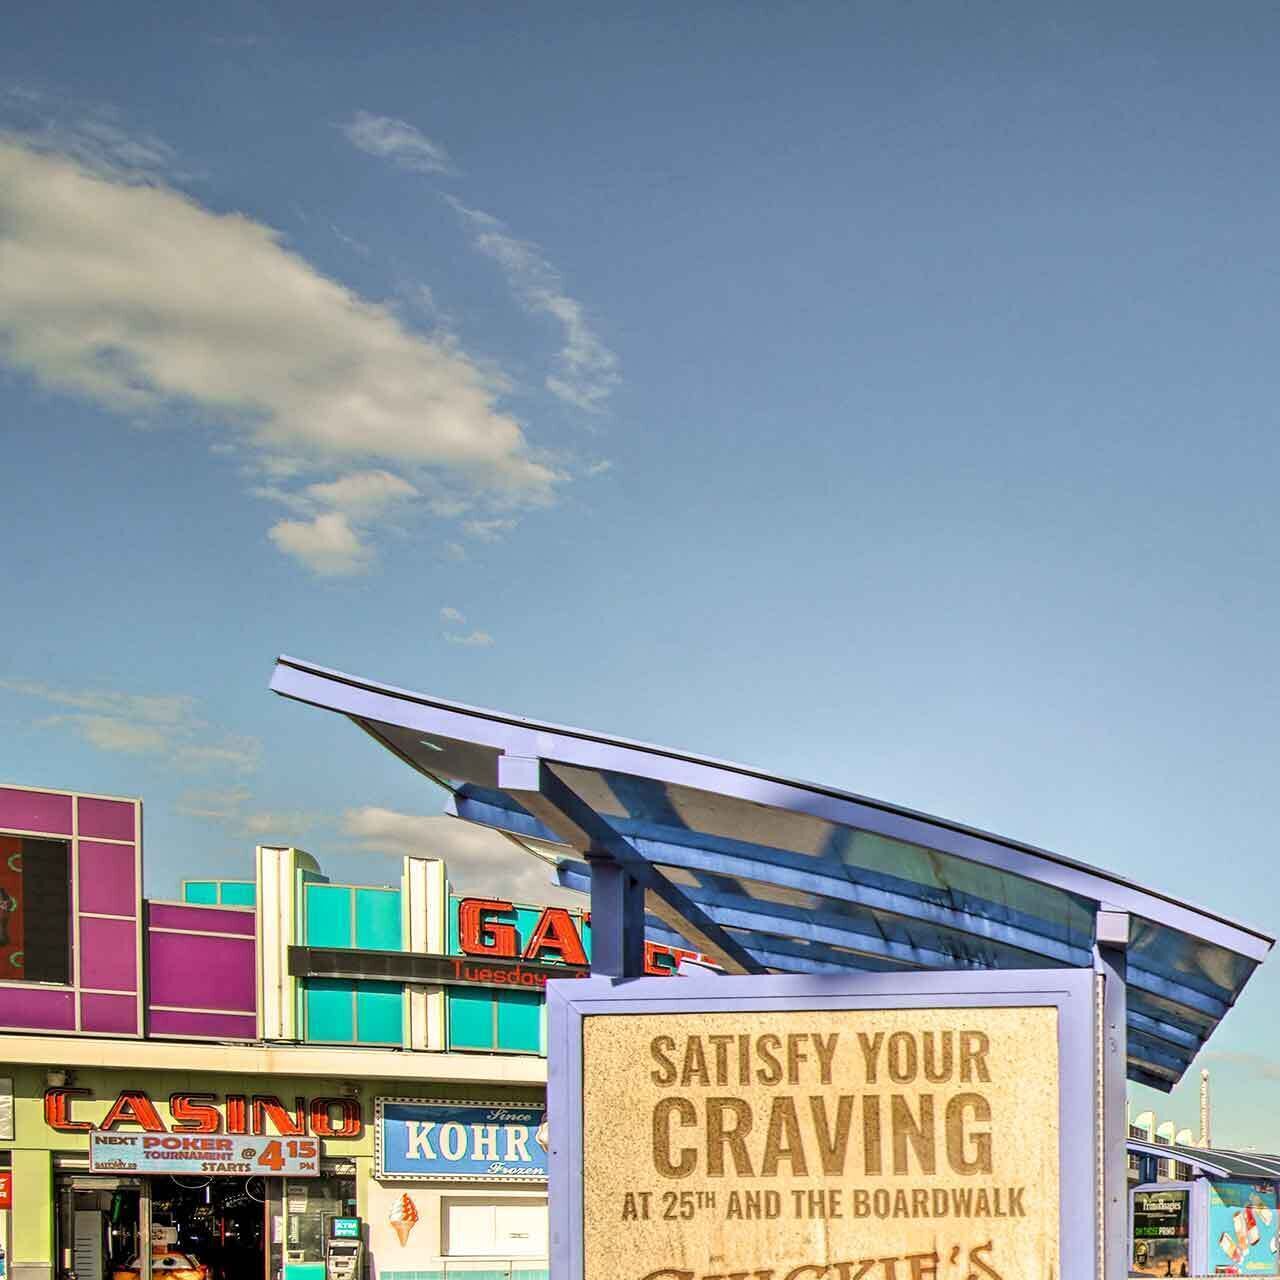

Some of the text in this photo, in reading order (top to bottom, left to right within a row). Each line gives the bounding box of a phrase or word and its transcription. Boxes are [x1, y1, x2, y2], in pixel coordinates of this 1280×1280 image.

[453, 960, 547, 986] Tuesday
[650, 1030, 992, 1087] SATISFY YOUR
[45, 1087, 363, 1138] CASINO
[486, 1109, 532, 1122] Since
[95, 1136, 138, 1146] NEXT
[142, 1136, 234, 1151] POKER
[405, 1120, 533, 1162] KOHR
[652, 1092, 993, 1179] CRAVING
[144, 1151, 234, 1162] TOURNAMENT
[201, 1162, 252, 1173] STARTS
[299, 1162, 315, 1171] PM
[487, 1161, 544, 1176] Frozen
[622, 1187, 1027, 1221] AT 25TH AND THE BOARDWALK
